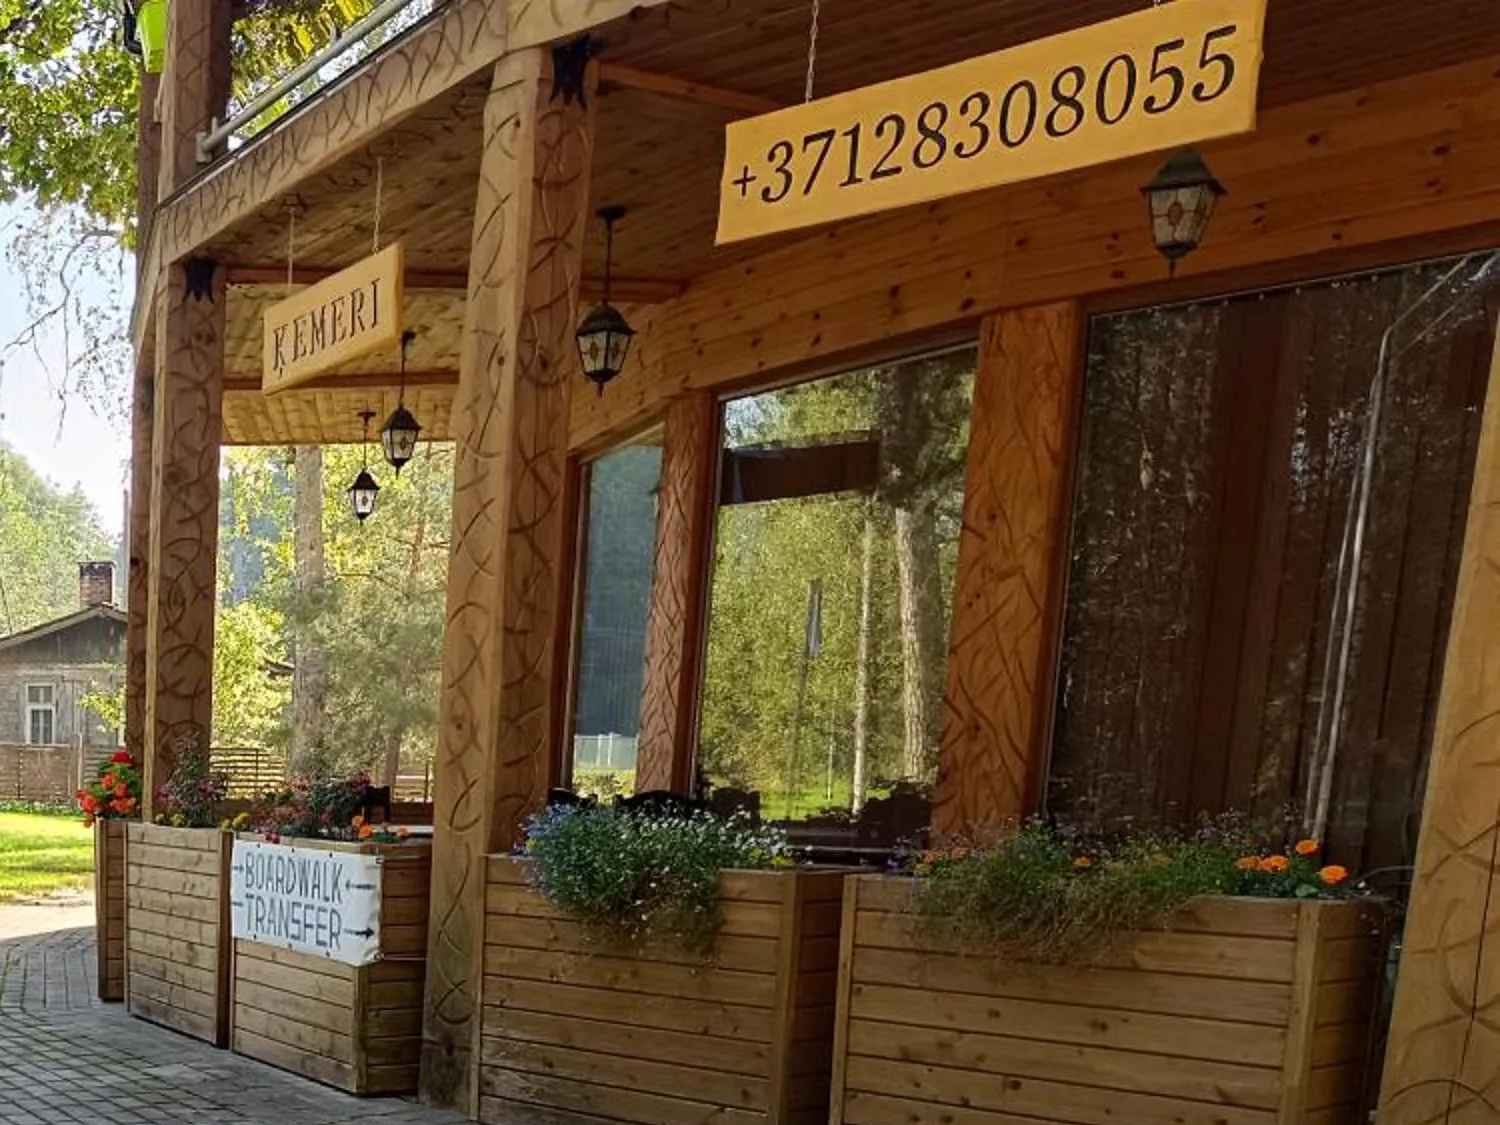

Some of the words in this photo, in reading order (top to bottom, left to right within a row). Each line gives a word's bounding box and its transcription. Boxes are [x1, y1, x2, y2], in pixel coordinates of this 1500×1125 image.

[733, 25, 1237, 203] +37128308055
[245, 852, 344, 903] BOARDWALK
[245, 892, 343, 949] TRANSFER
